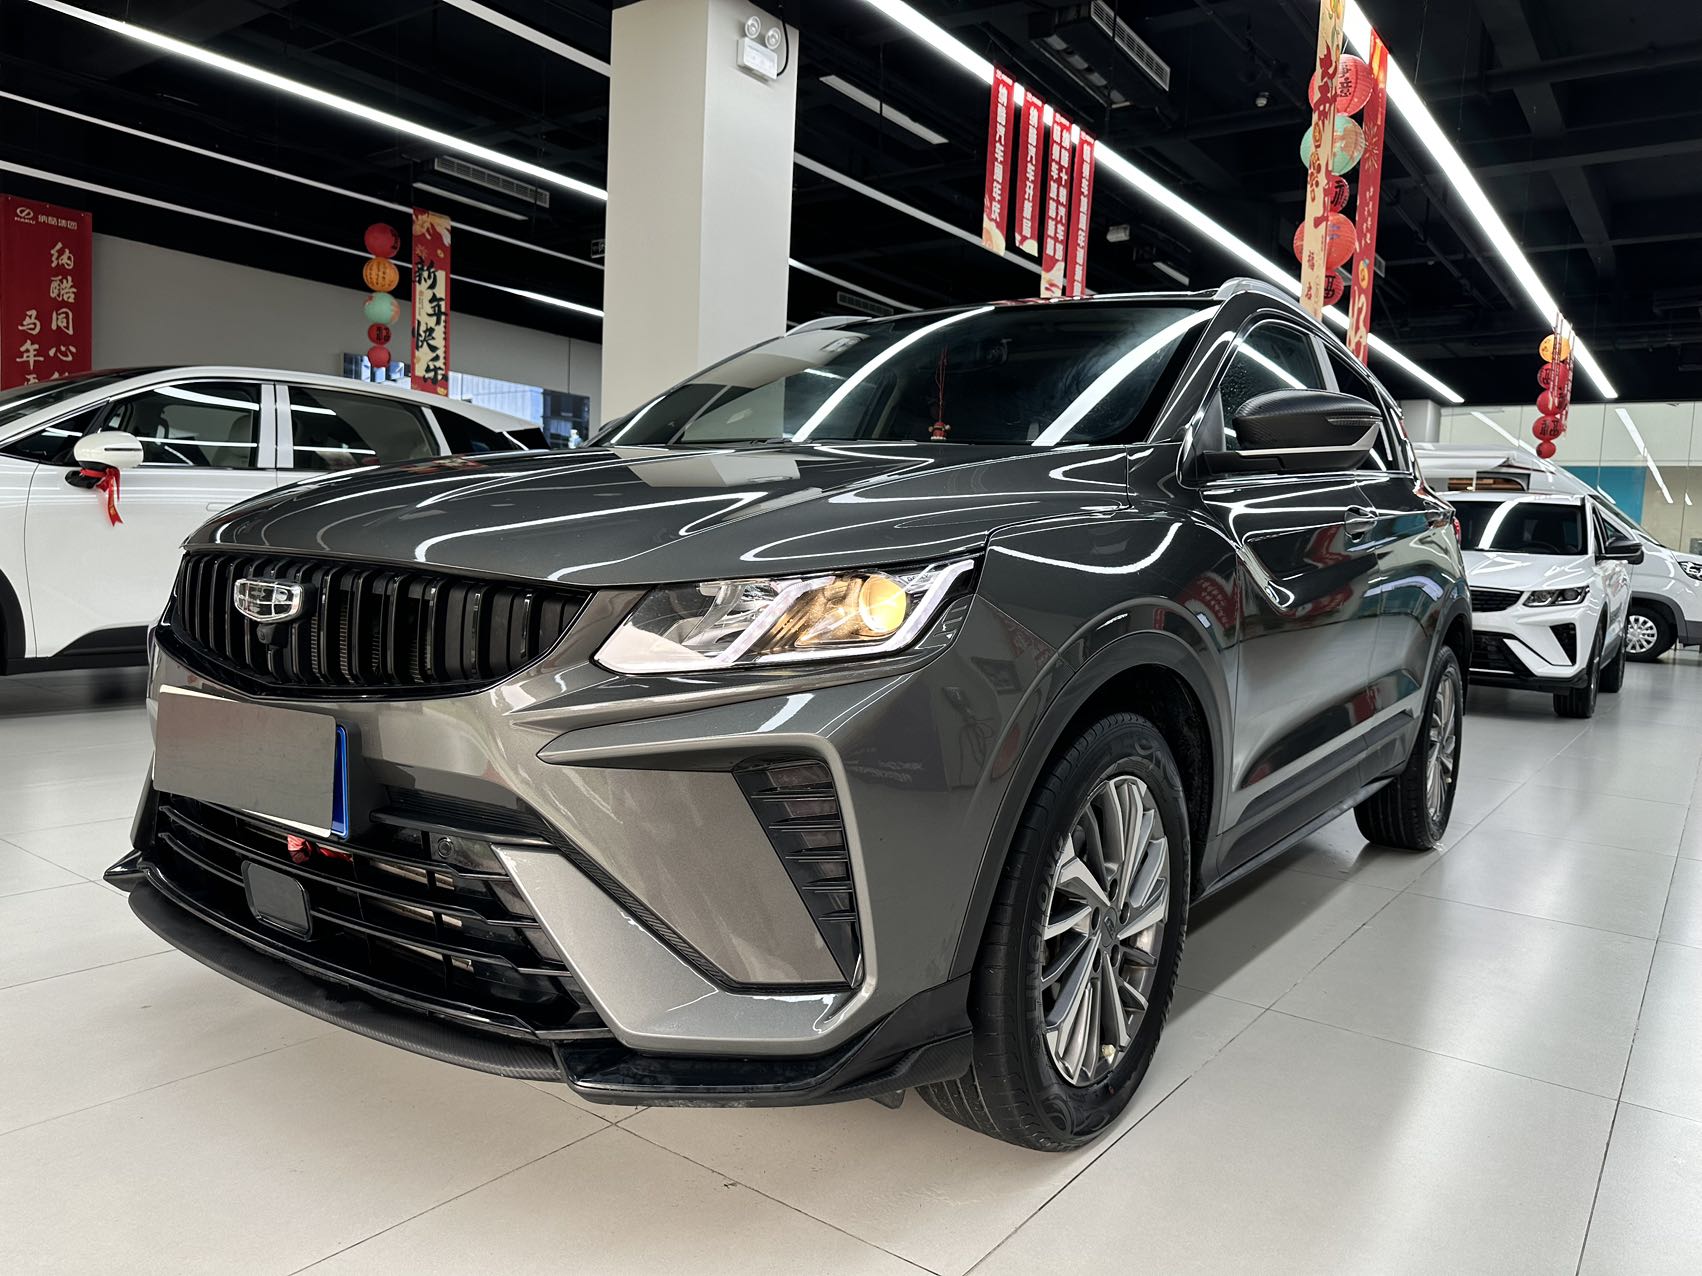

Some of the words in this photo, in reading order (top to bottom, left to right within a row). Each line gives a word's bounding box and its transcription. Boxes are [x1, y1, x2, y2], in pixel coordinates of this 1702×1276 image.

[49, 242, 78, 380] 纳酷同心
[411, 257, 448, 385] 新年快乐
